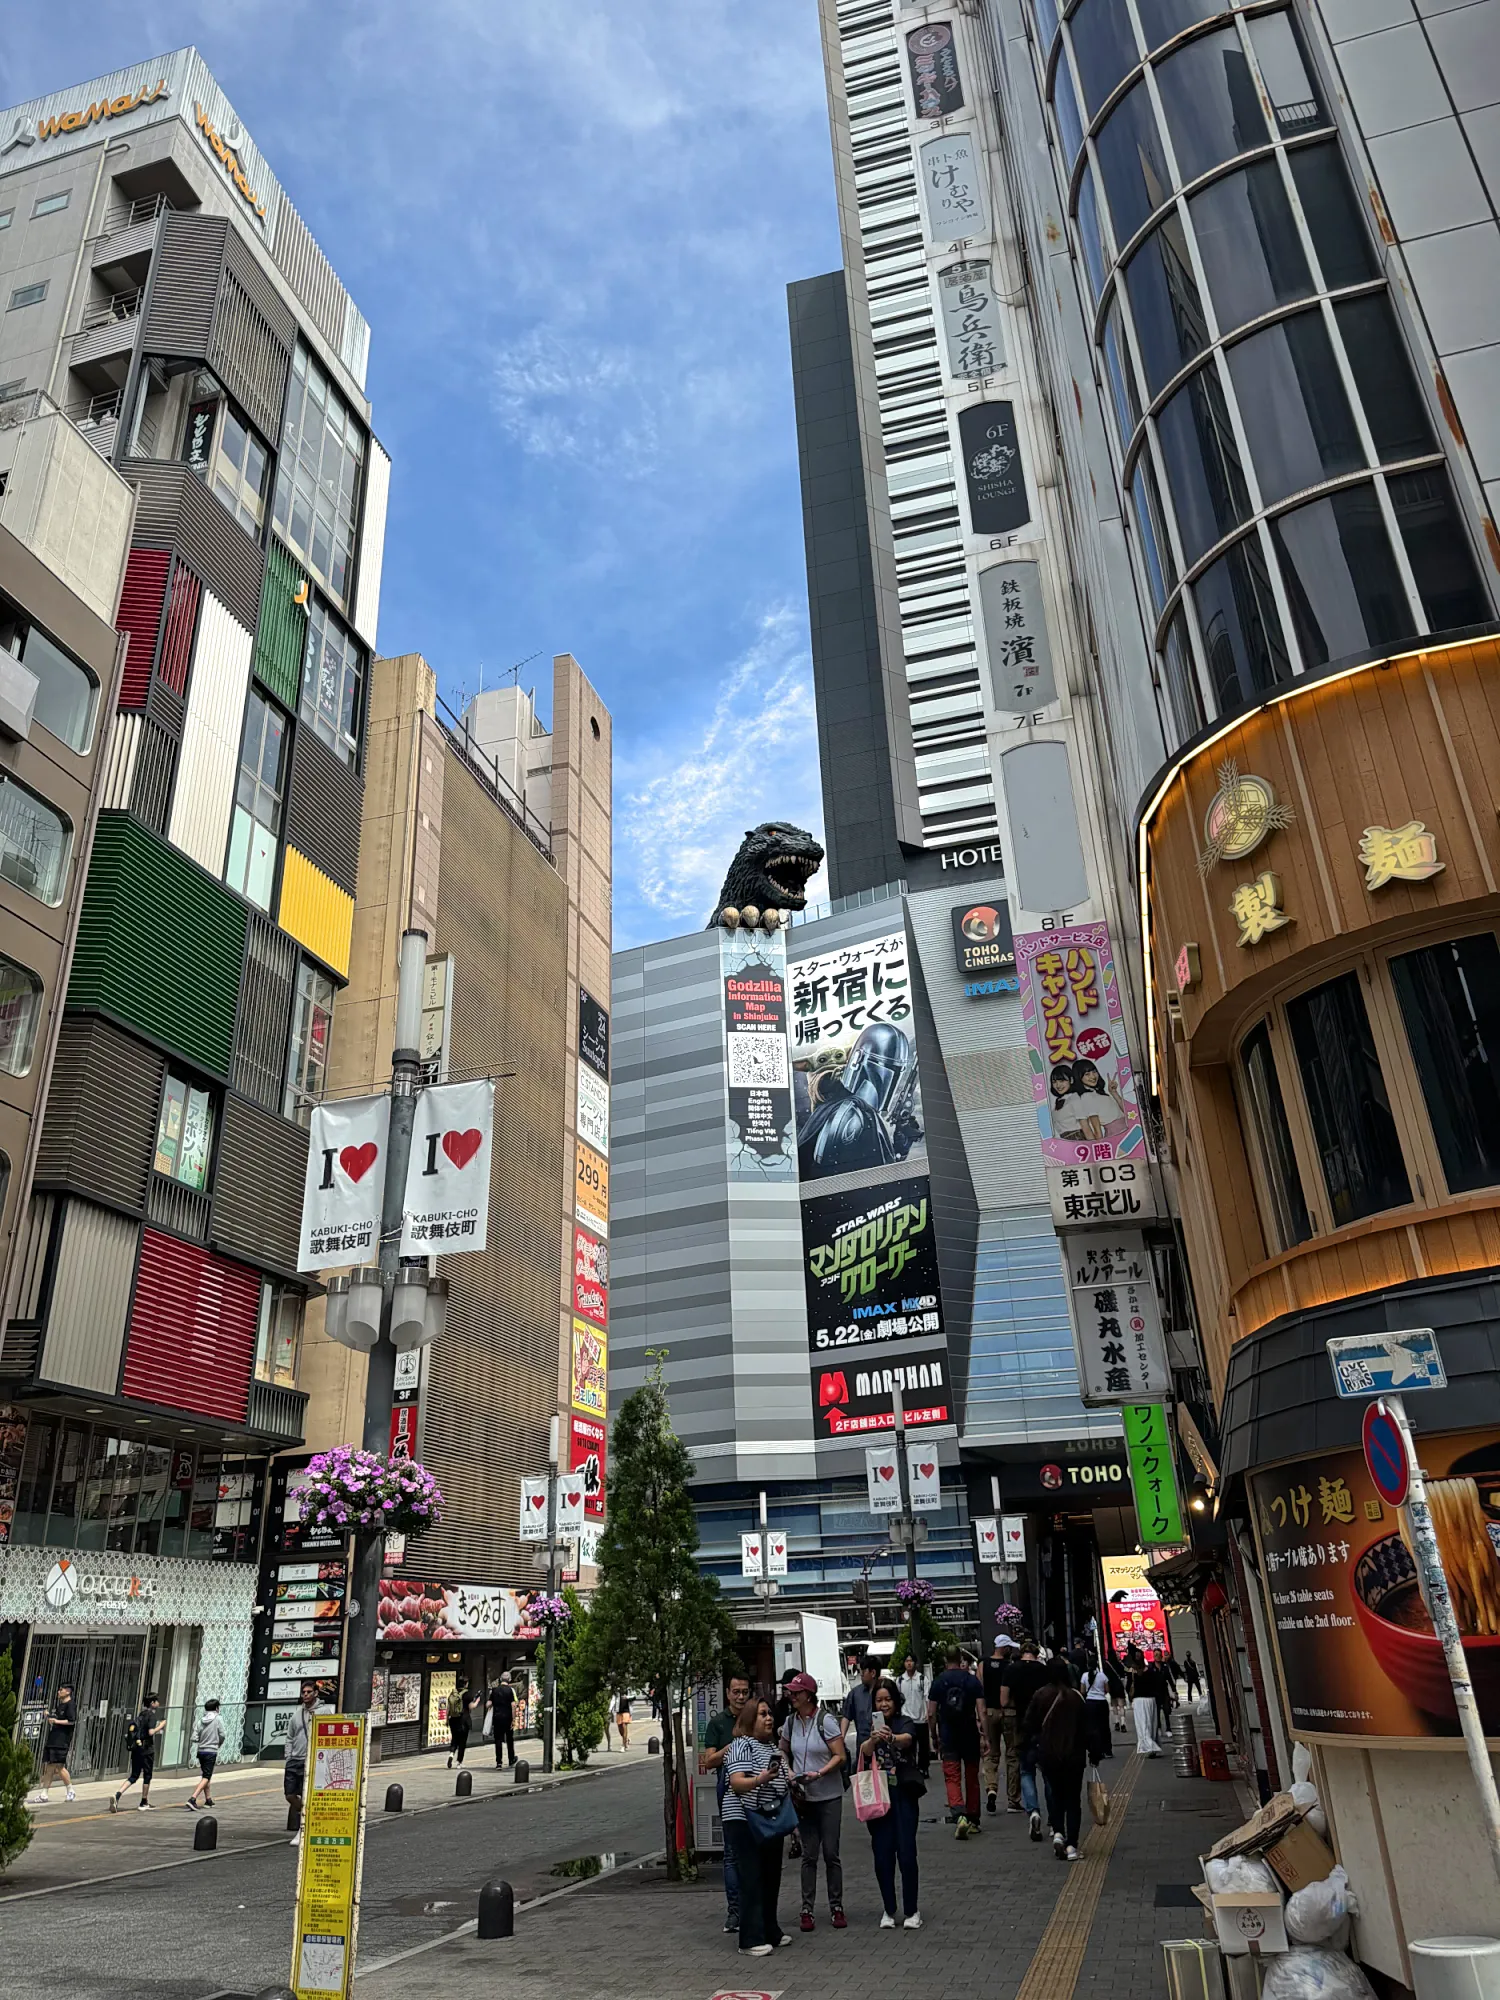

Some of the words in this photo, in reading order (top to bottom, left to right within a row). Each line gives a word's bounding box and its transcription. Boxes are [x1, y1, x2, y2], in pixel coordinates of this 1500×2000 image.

[986, 424, 1009, 439] 6F
[978, 479, 1014, 491] SHISHA
[978, 487, 1017, 500] LOUNGE
[990, 535, 1018, 550] 6F
[1013, 684, 1034, 697] 7F
[1013, 712, 1045, 729] 7F
[1042, 914, 1074, 930] 8F
[964, 943, 999, 958] TOHO
[1018, 932, 1107, 959] ハンドサービス店
[793, 937, 904, 979] スター・ウォーズが
[965, 952, 1014, 968] CINEMAS
[727, 979, 782, 992] Godzilla
[794, 959, 907, 1017] 新宿に
[1065, 947, 1099, 1019] ハンド
[728, 992, 782, 1002] Information
[745, 1002, 765, 1012] Map
[744, 1012, 779, 1021] Shinjuku
[795, 994, 911, 1046] 帰ってくる
[1076, 1031, 1111, 1053] 新宿
[422, 1133, 441, 1176] I
[1075, 1142, 1112, 1163] 9階
[318, 1148, 338, 1190] I
[578, 1158, 599, 1191] 299
[1060, 1164, 1136, 1188] 第103
[1063, 1188, 1141, 1220] 東京ビル
[412, 1208, 478, 1224] KABUKI-CHO
[832, 1215, 867, 1238] STAR
[867, 1197, 902, 1220] WARS
[310, 1221, 373, 1238] KABUKI-CHO
[410, 1219, 478, 1241] 歌舞伎町
[309, 1231, 372, 1255] 歌舞伎町
[809, 1198, 927, 1278] マンダロリアン
[820, 1272, 840, 1287] アンド
[1077, 1262, 1143, 1284] ルノアール
[853, 1302, 897, 1320] IMAX
[901, 1294, 937, 1310] MX4D
[1094, 1288, 1132, 1392] 磯丸水産
[399, 1390, 411, 1400] 3F
[873, 1467, 880, 1483] I
[912, 1464, 920, 1480] I
[1067, 1464, 1122, 1484] TOHO
[525, 1496, 530, 1511] I
[561, 1493, 566, 1509] I
[1270, 1476, 1356, 1529] つけ麺
[275, 1506, 282, 1514] 10
[270, 1570, 275, 1578] 8
[1297, 1589, 1313, 1602] table
[1313, 1589, 1334, 1601] seats
[267, 1608, 271, 1616] 6
[458, 1590, 513, 1635] きづなすし
[1304, 1616, 1315, 1628] the
[1315, 1613, 1330, 1628] 2nd
[1330, 1613, 1356, 1627] floor.
[328, 1724, 350, 1735] 警告
[317, 1737, 358, 1746] 放置禁止区域
